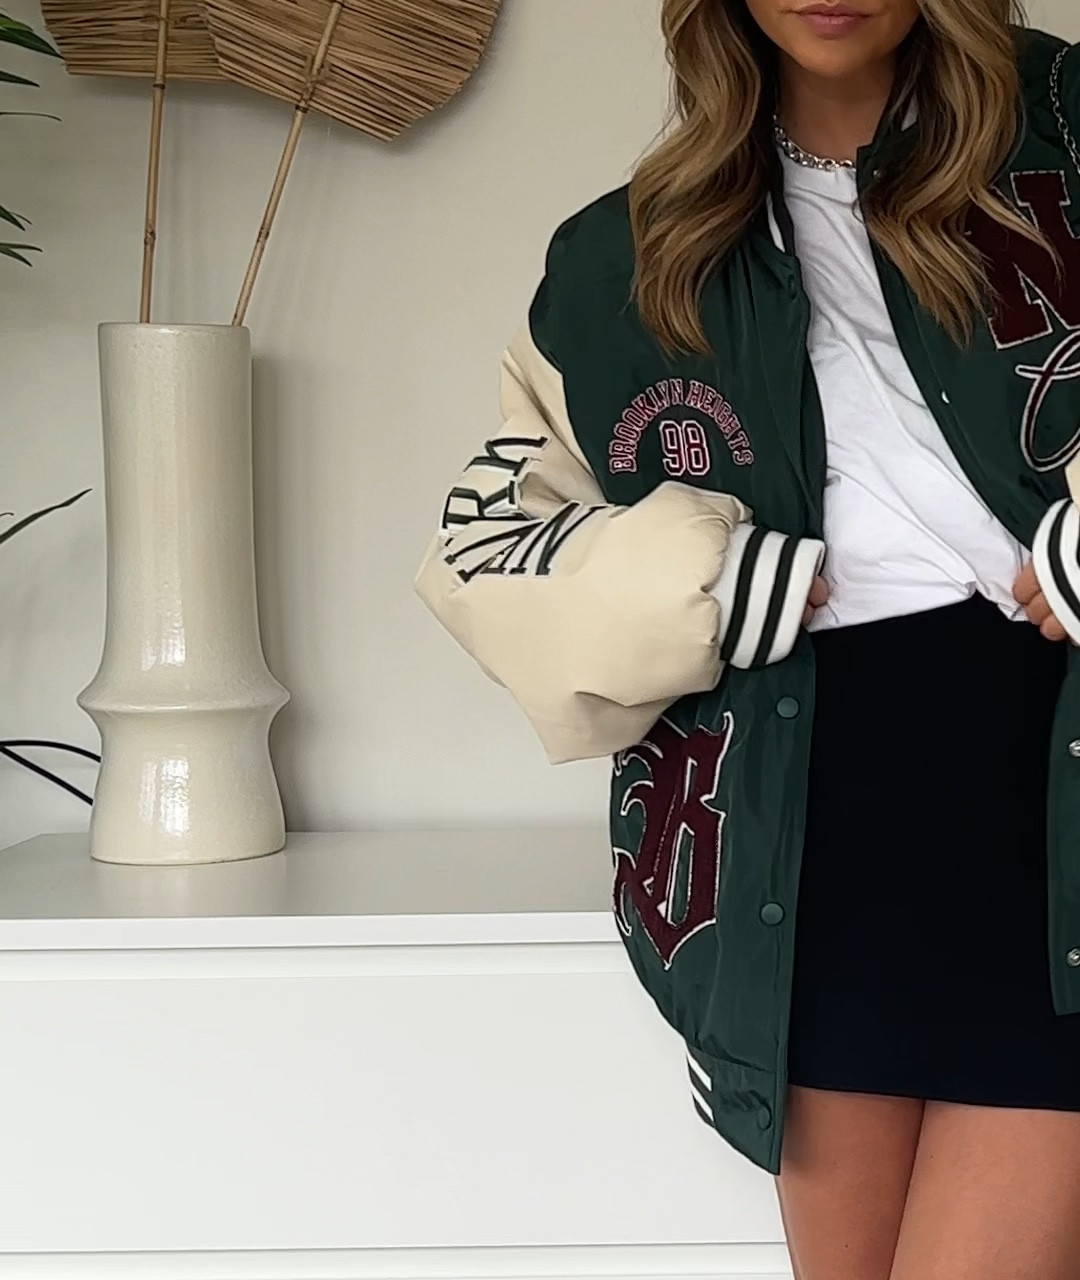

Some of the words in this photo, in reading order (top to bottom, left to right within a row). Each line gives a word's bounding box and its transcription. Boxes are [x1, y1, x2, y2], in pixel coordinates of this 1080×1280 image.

[609, 378, 683, 473] BROOKLYN
[685, 380, 754, 466] HEIGHTS
[659, 420, 710, 476] 98
